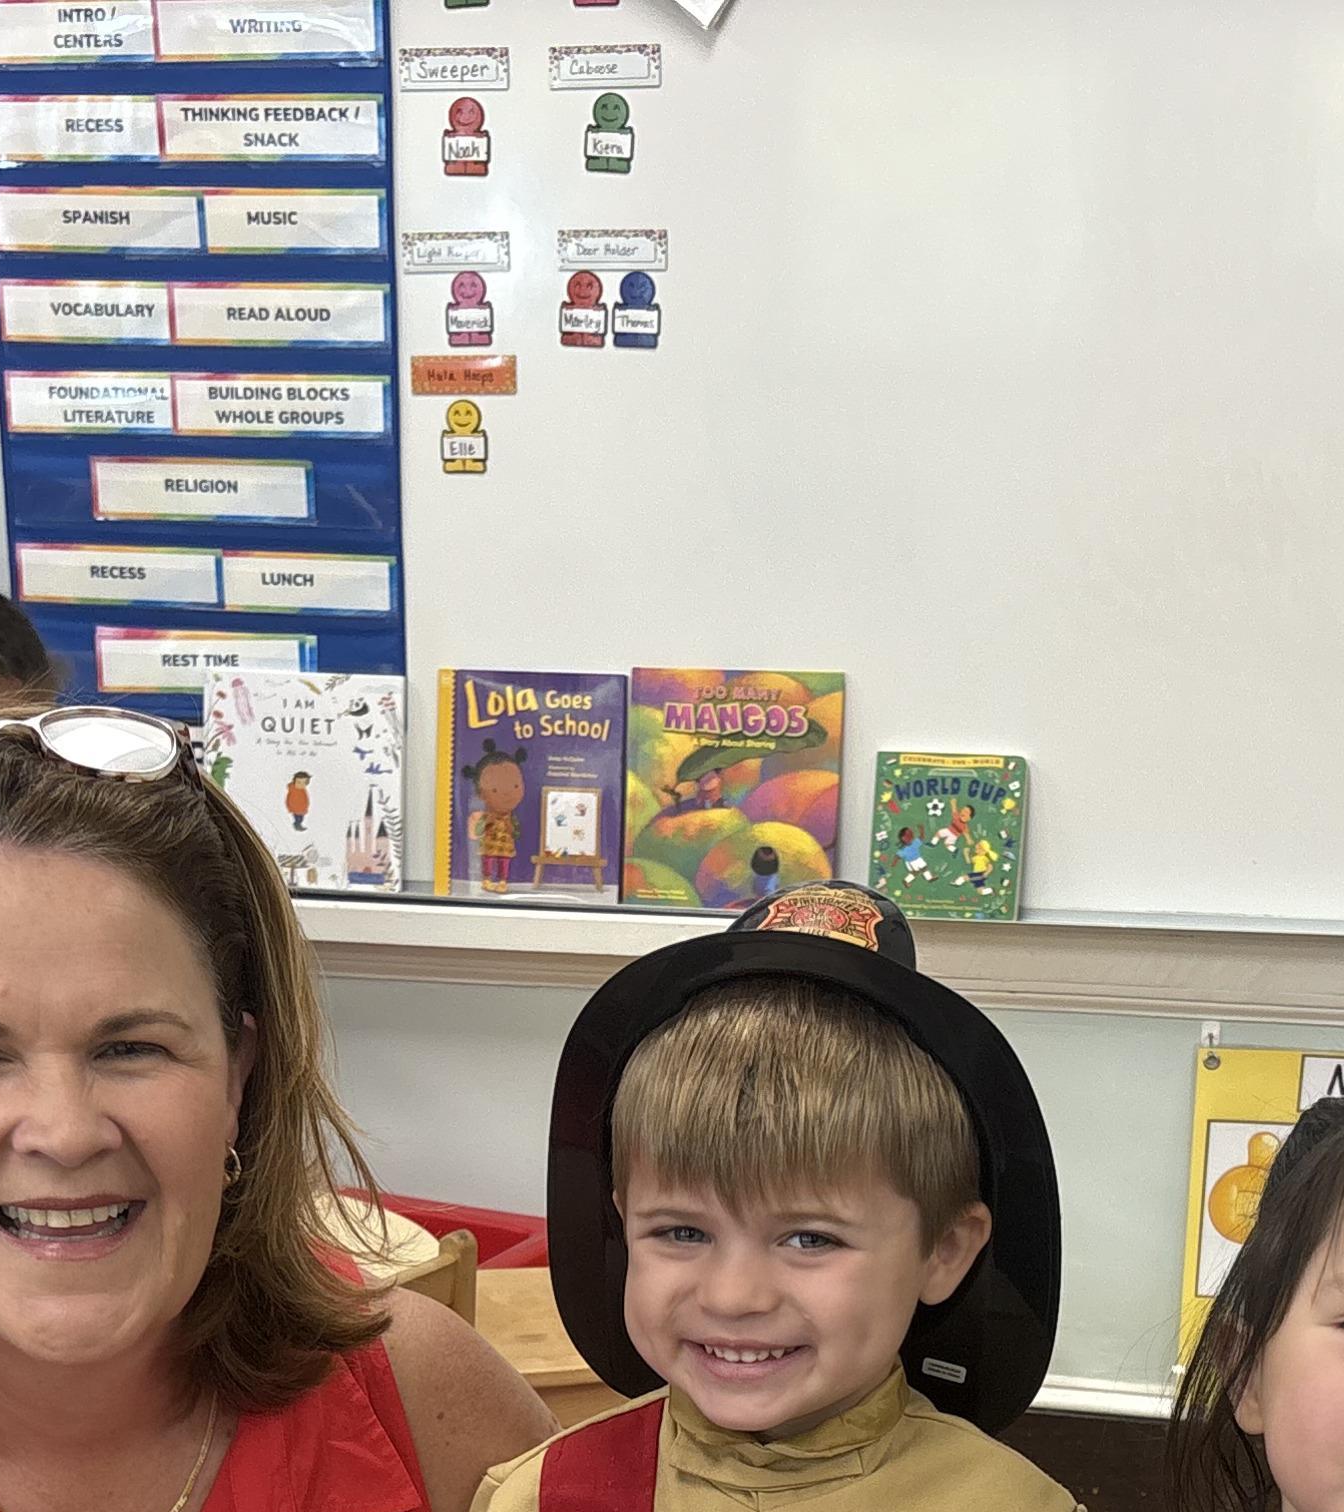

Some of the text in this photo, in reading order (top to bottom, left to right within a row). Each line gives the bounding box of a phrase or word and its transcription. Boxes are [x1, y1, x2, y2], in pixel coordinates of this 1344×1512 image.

[57, 8, 105, 23] INTRO
[54, 34, 123, 48] CENTERS
[416, 61, 489, 82] Sweeper
[569, 60, 618, 75] Caboose
[180, 106, 260, 122] THINKING
[264, 106, 350, 122] FEEDBACK
[65, 118, 124, 133] RECESS
[243, 133, 299, 147] SNACK
[448, 142, 480, 158] Noah
[62, 210, 130, 226] SPANISH
[247, 211, 298, 226] MUSIC
[50, 302, 155, 318] VOCABULARY
[226, 307, 331, 323] READ ALOUD
[48, 385, 168, 401] FOUNDATIONAL
[208, 386, 351, 401] BUILDING BLOCKS
[63, 409, 155, 424] LITERATURE
[215, 410, 345, 425] WHOLE GROUPS
[164, 478, 238, 494] RELIGION
[90, 565, 146, 580] RECESS
[261, 572, 314, 587] LUNCH
[161, 653, 239, 668] REST TIME
[695, 685, 784, 701] TOO MANY
[293, 698, 316, 710] AM
[464, 678, 592, 730] Lola Goes
[260, 714, 337, 736] QUIET
[663, 702, 808, 737] MANGOS
[514, 714, 610, 742] to School
[895, 777, 1007, 804] WORLD CUP
